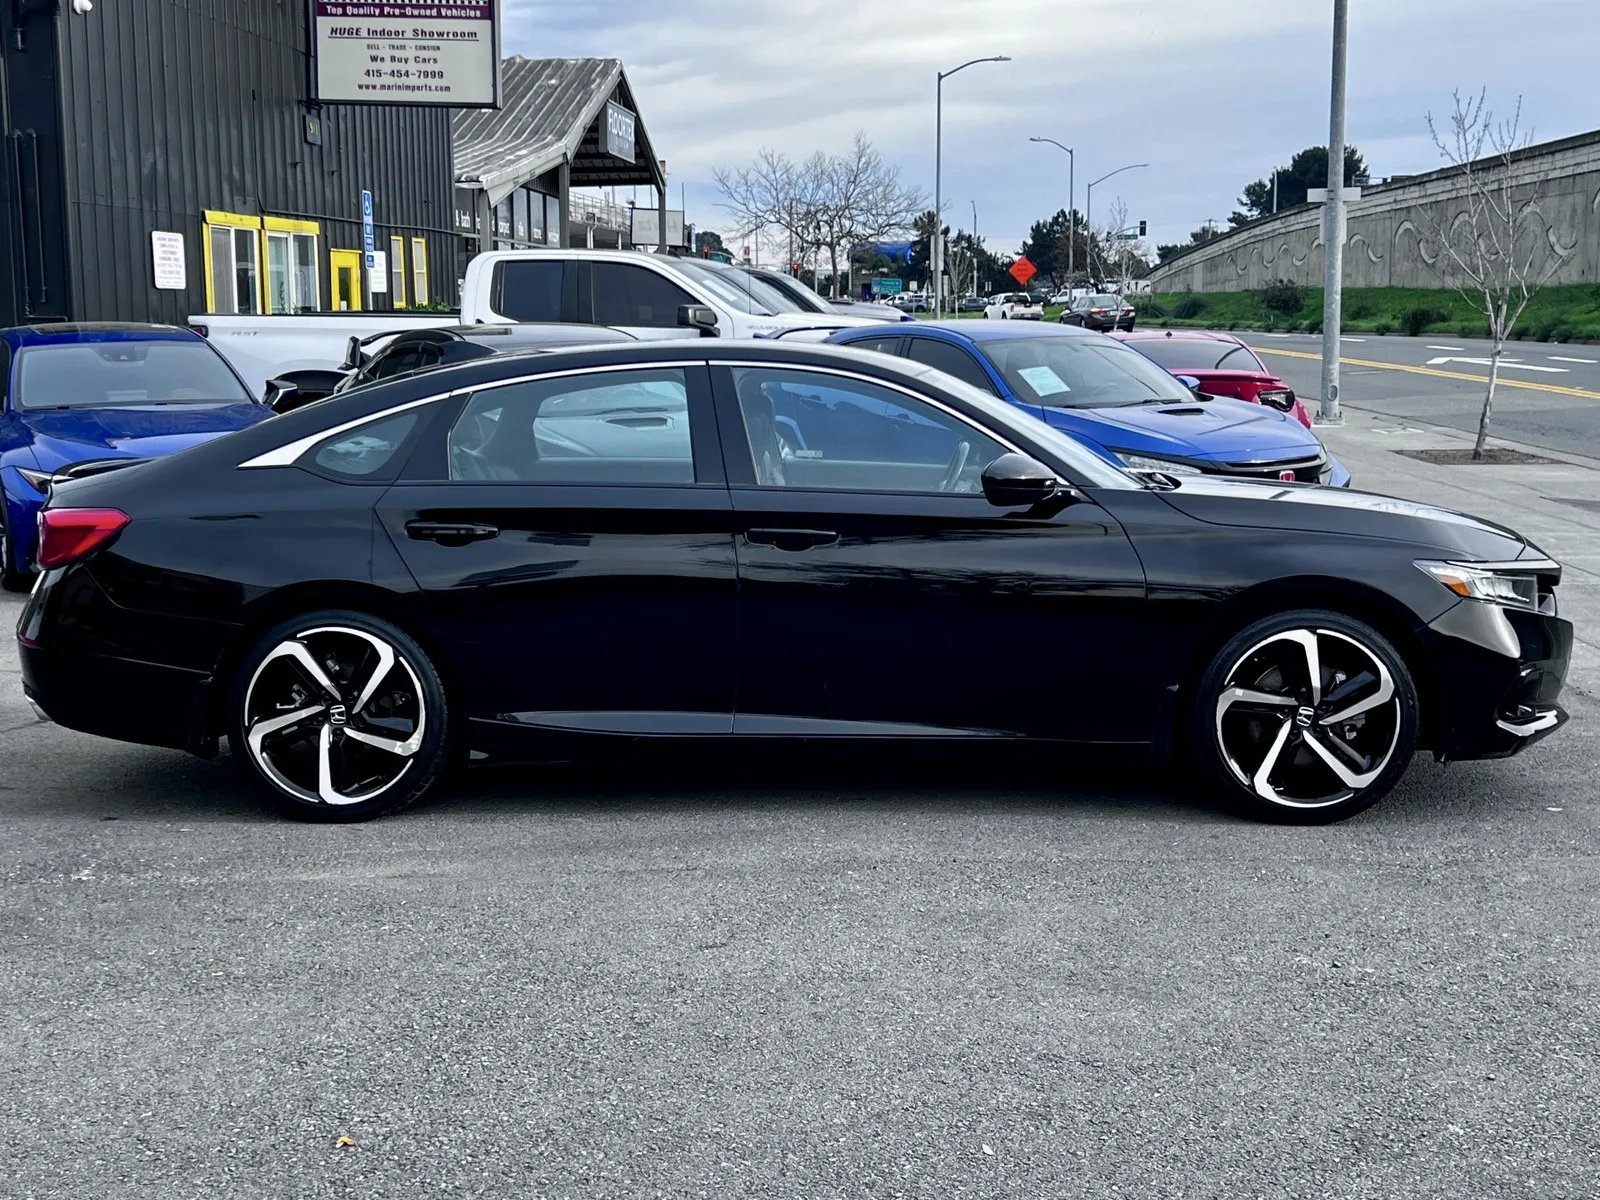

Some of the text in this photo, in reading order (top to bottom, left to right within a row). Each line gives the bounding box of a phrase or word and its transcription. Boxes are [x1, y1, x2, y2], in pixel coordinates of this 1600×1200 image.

[326, 5, 481, 17] Top Quality Pre-Owned Vehicles
[330, 26, 477, 39] HUGE Indoor Showroom
[369, 54, 438, 64] We Buy Cars
[364, 68, 444, 79] 415-454-7999
[357, 83, 451, 92] www.marinimports.com
